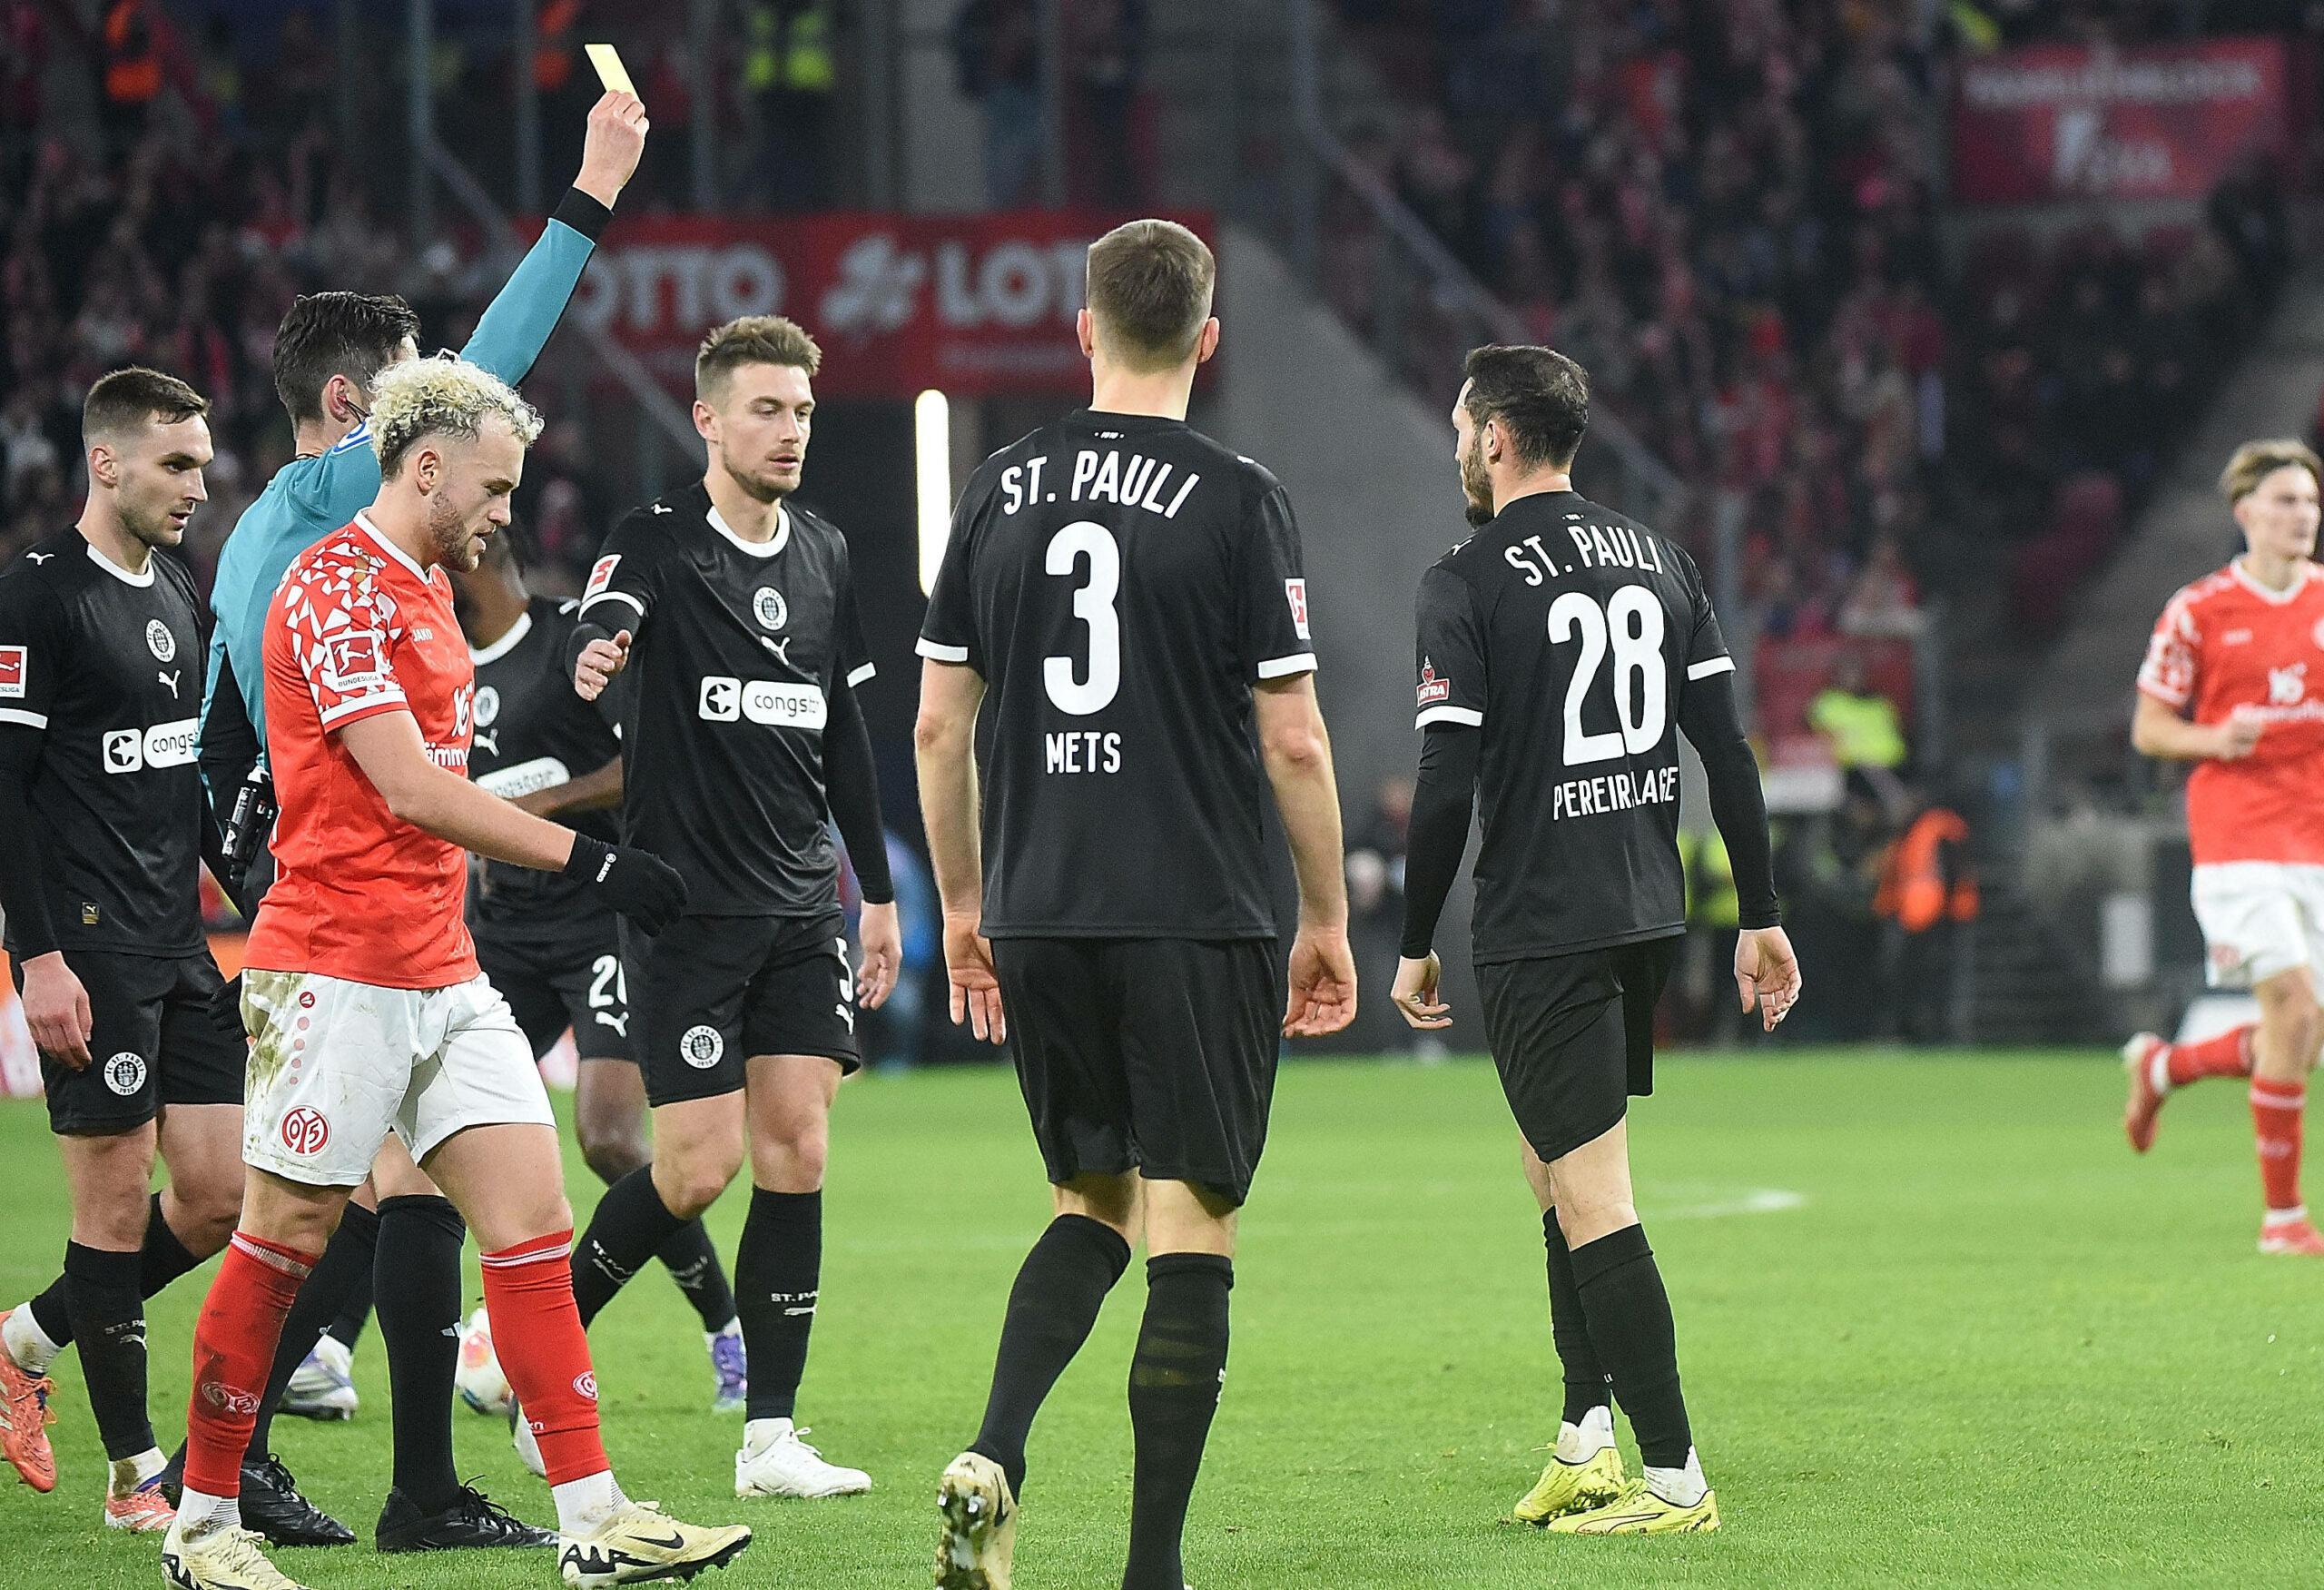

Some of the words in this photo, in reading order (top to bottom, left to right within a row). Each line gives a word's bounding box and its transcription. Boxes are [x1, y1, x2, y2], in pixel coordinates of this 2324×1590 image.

[572, 241, 787, 331] OTTO
[935, 238, 1090, 329] LOT
[1000, 456, 1057, 515] ST.
[1070, 450, 1200, 518] PAULI
[1504, 535, 1573, 587] ST.
[1567, 525, 1663, 575] PAULI
[412, 627, 433, 642] JAKO
[1043, 520, 1120, 716] 3
[338, 676, 379, 687] BUNDESLIGA
[1547, 584, 1667, 766] 28
[1046, 731, 1121, 774] METS
[771, 1292, 796, 1302] ST.
[797, 1290, 820, 1302] PA
